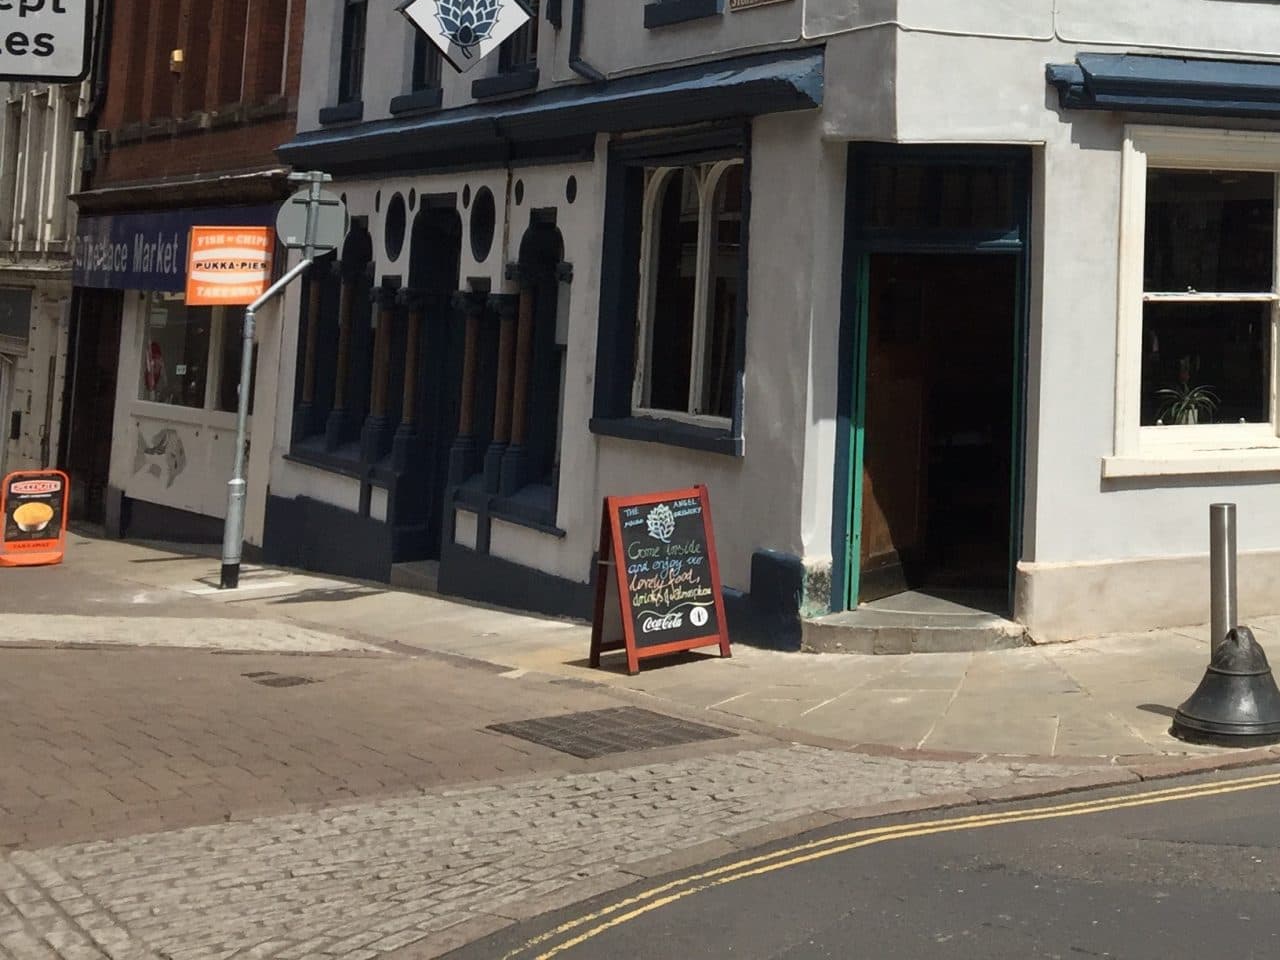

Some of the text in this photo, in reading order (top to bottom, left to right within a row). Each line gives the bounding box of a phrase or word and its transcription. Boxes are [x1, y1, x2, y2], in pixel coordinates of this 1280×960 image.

[0, 31, 56, 57] es
[132, 231, 178, 275] Market
[624, 507, 639, 518] THE
[627, 541, 660, 560] Come
[628, 556, 703, 579] and enjoy our
